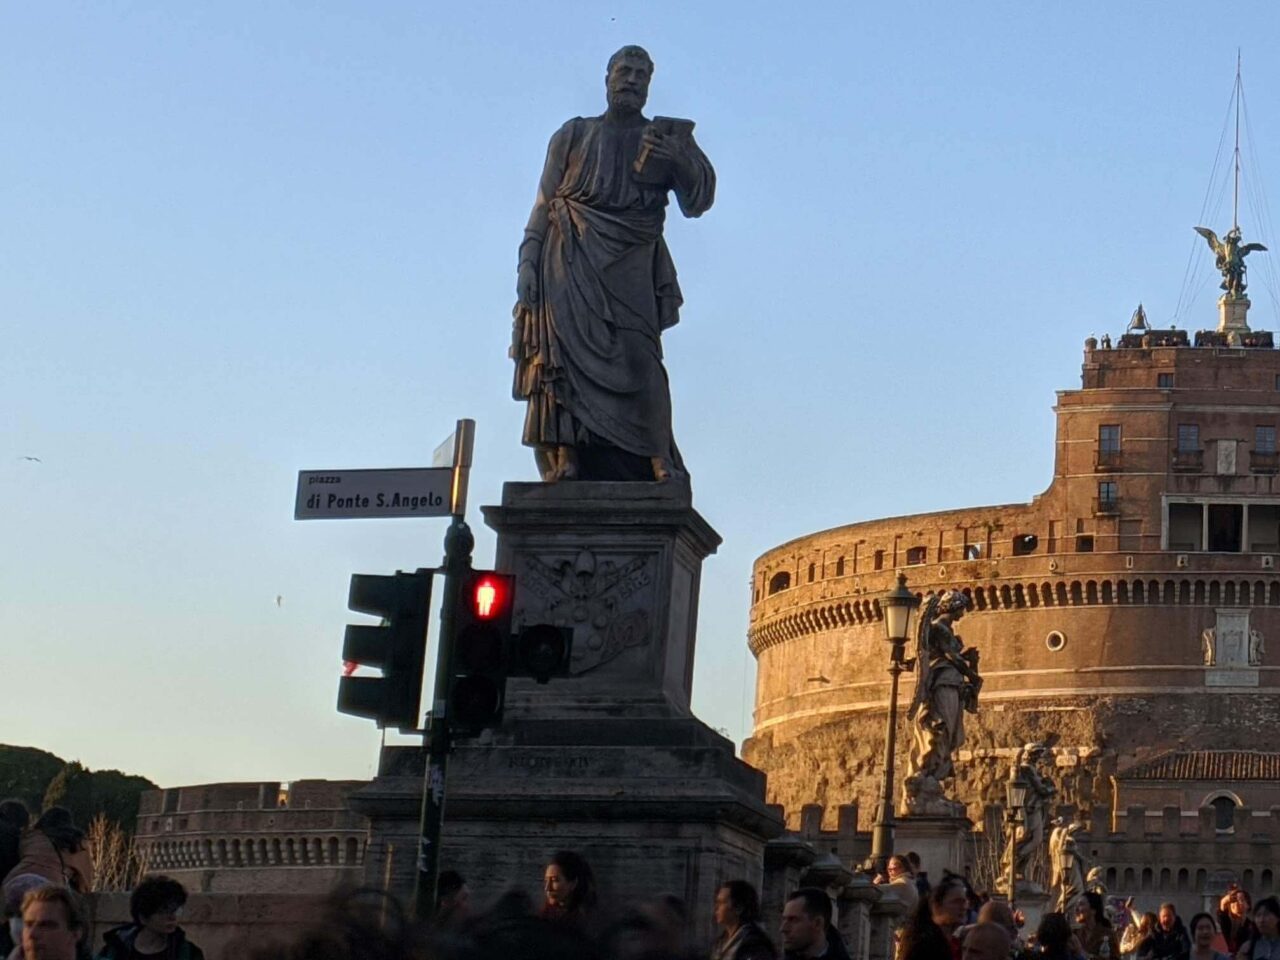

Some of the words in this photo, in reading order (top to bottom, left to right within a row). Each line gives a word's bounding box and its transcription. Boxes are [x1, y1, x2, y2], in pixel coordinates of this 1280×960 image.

[308, 475, 341, 485] piazza
[306, 493, 320, 509] di
[327, 493, 369, 509] Ponte
[376, 492, 443, 510] S.Angelo
